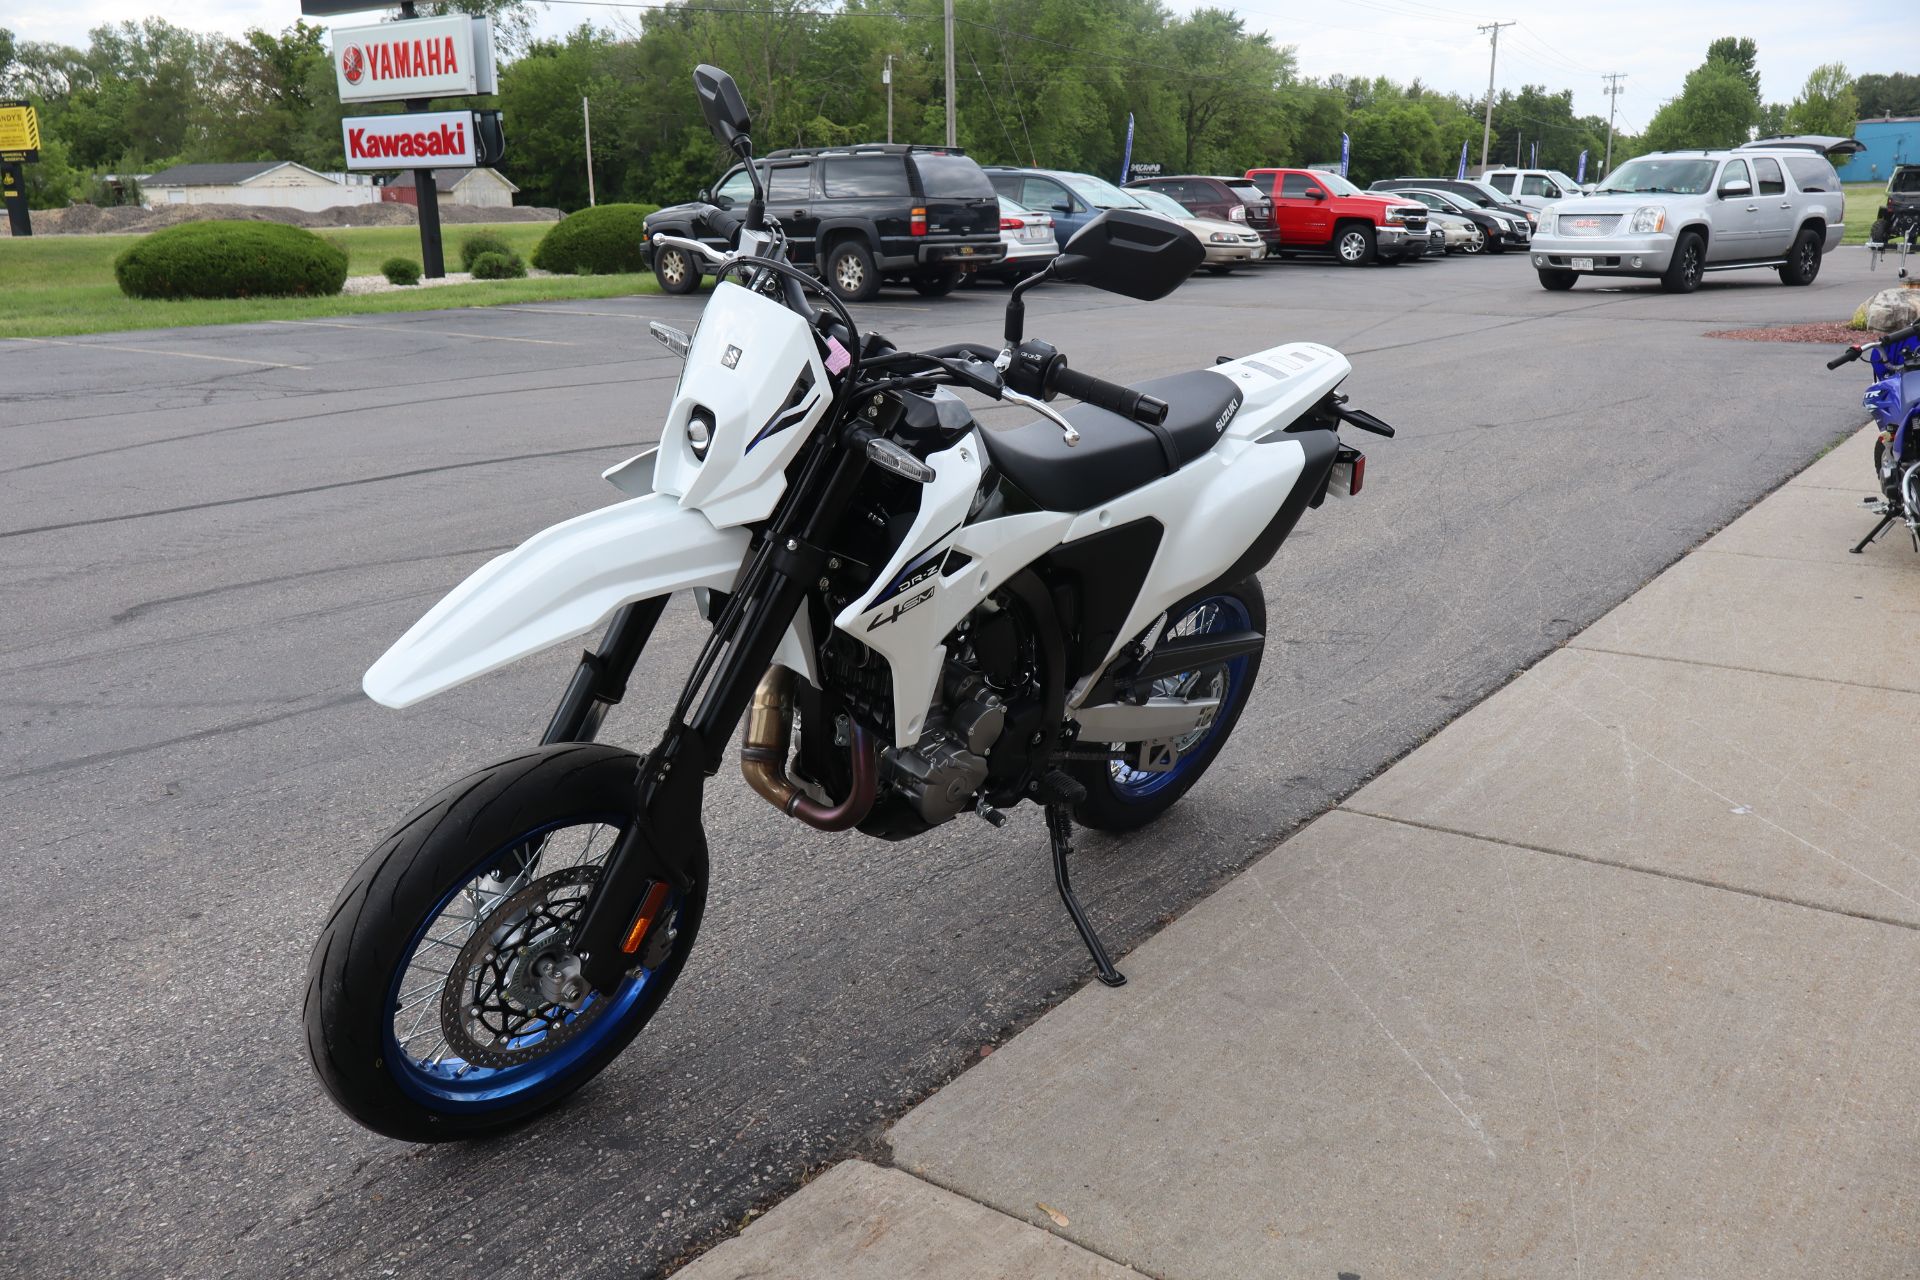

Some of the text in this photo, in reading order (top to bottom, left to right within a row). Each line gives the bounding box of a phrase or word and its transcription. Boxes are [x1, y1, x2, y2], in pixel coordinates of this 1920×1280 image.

[365, 35, 458, 81] YAMAHA
[348, 122, 466, 158] Kawasaki
[1215, 398, 1239, 432] SUZUKI
[898, 564, 938, 591] DR-Z
